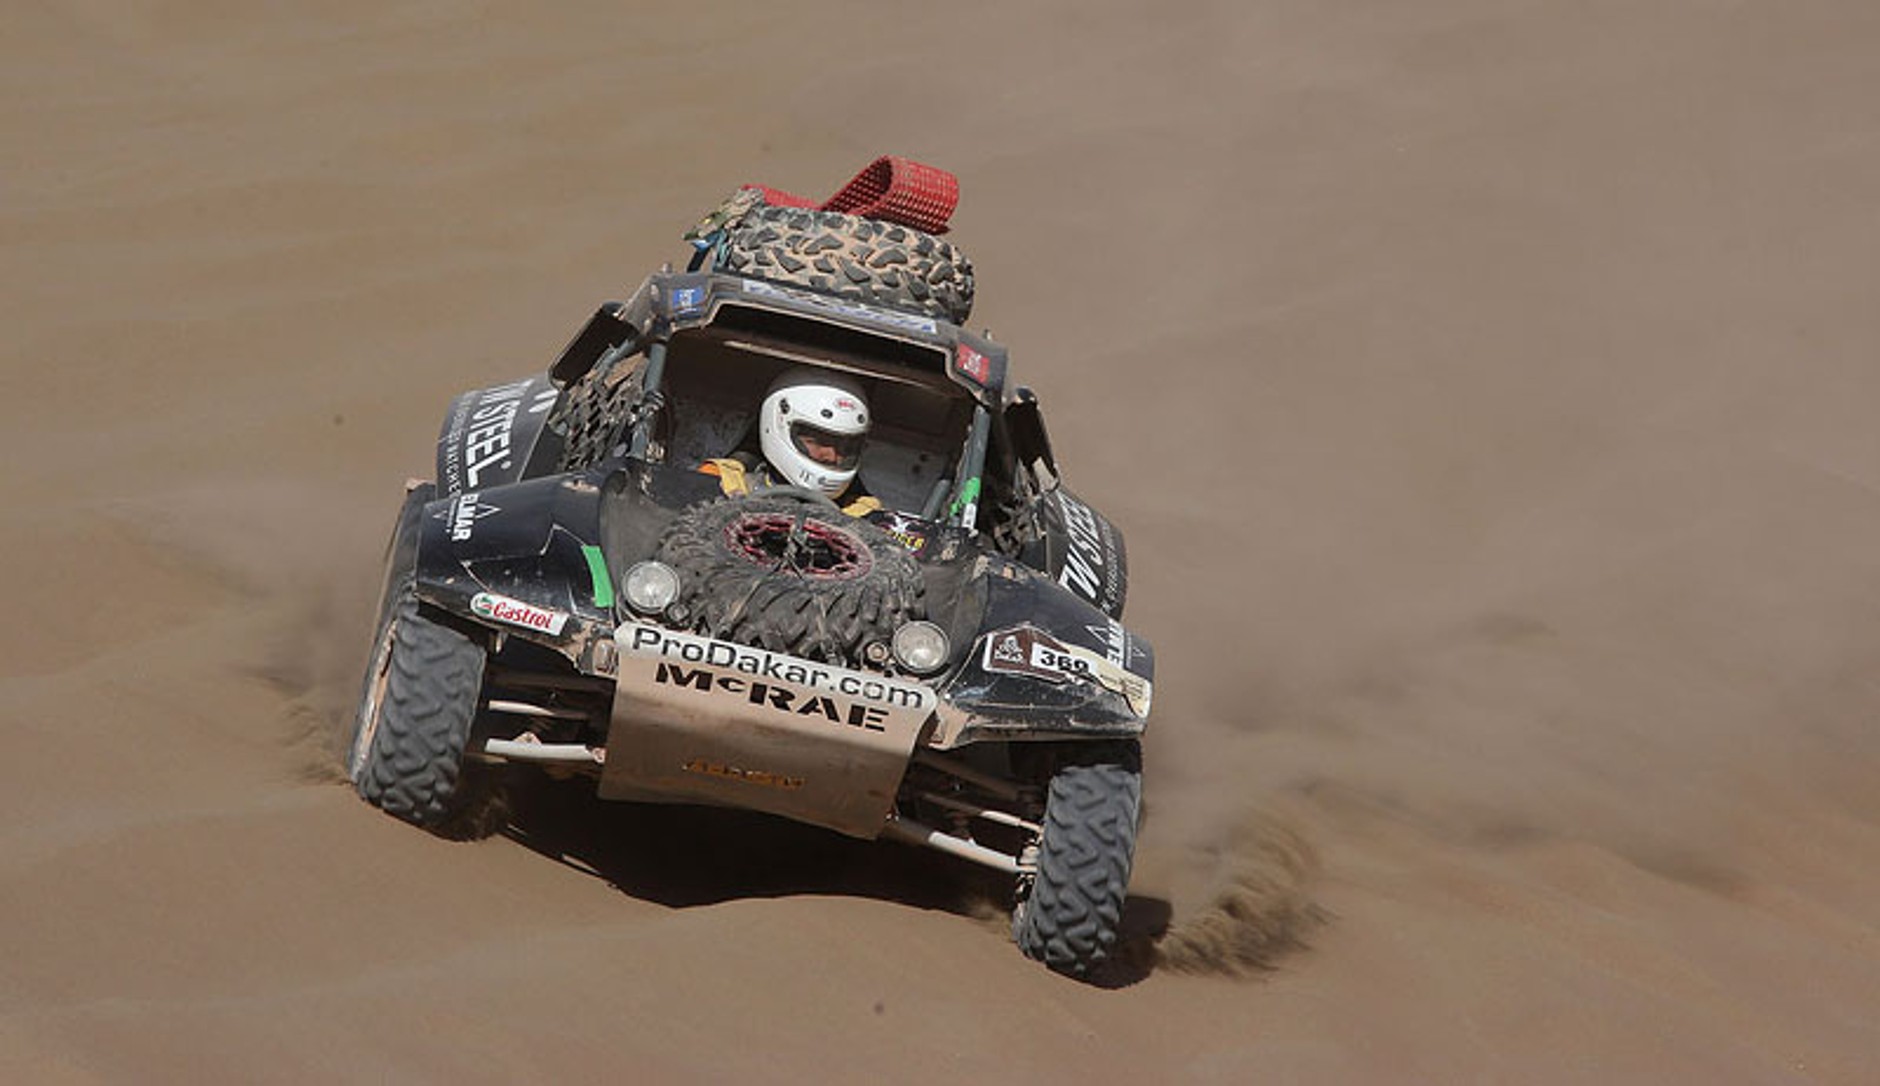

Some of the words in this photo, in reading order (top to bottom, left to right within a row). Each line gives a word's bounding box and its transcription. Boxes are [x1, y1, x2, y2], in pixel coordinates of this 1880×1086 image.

[465, 400, 521, 488] STEEL
[451, 493, 479, 541] ELMAR
[493, 601, 554, 628] Castrol
[632, 626, 924, 709] ProDakar.com
